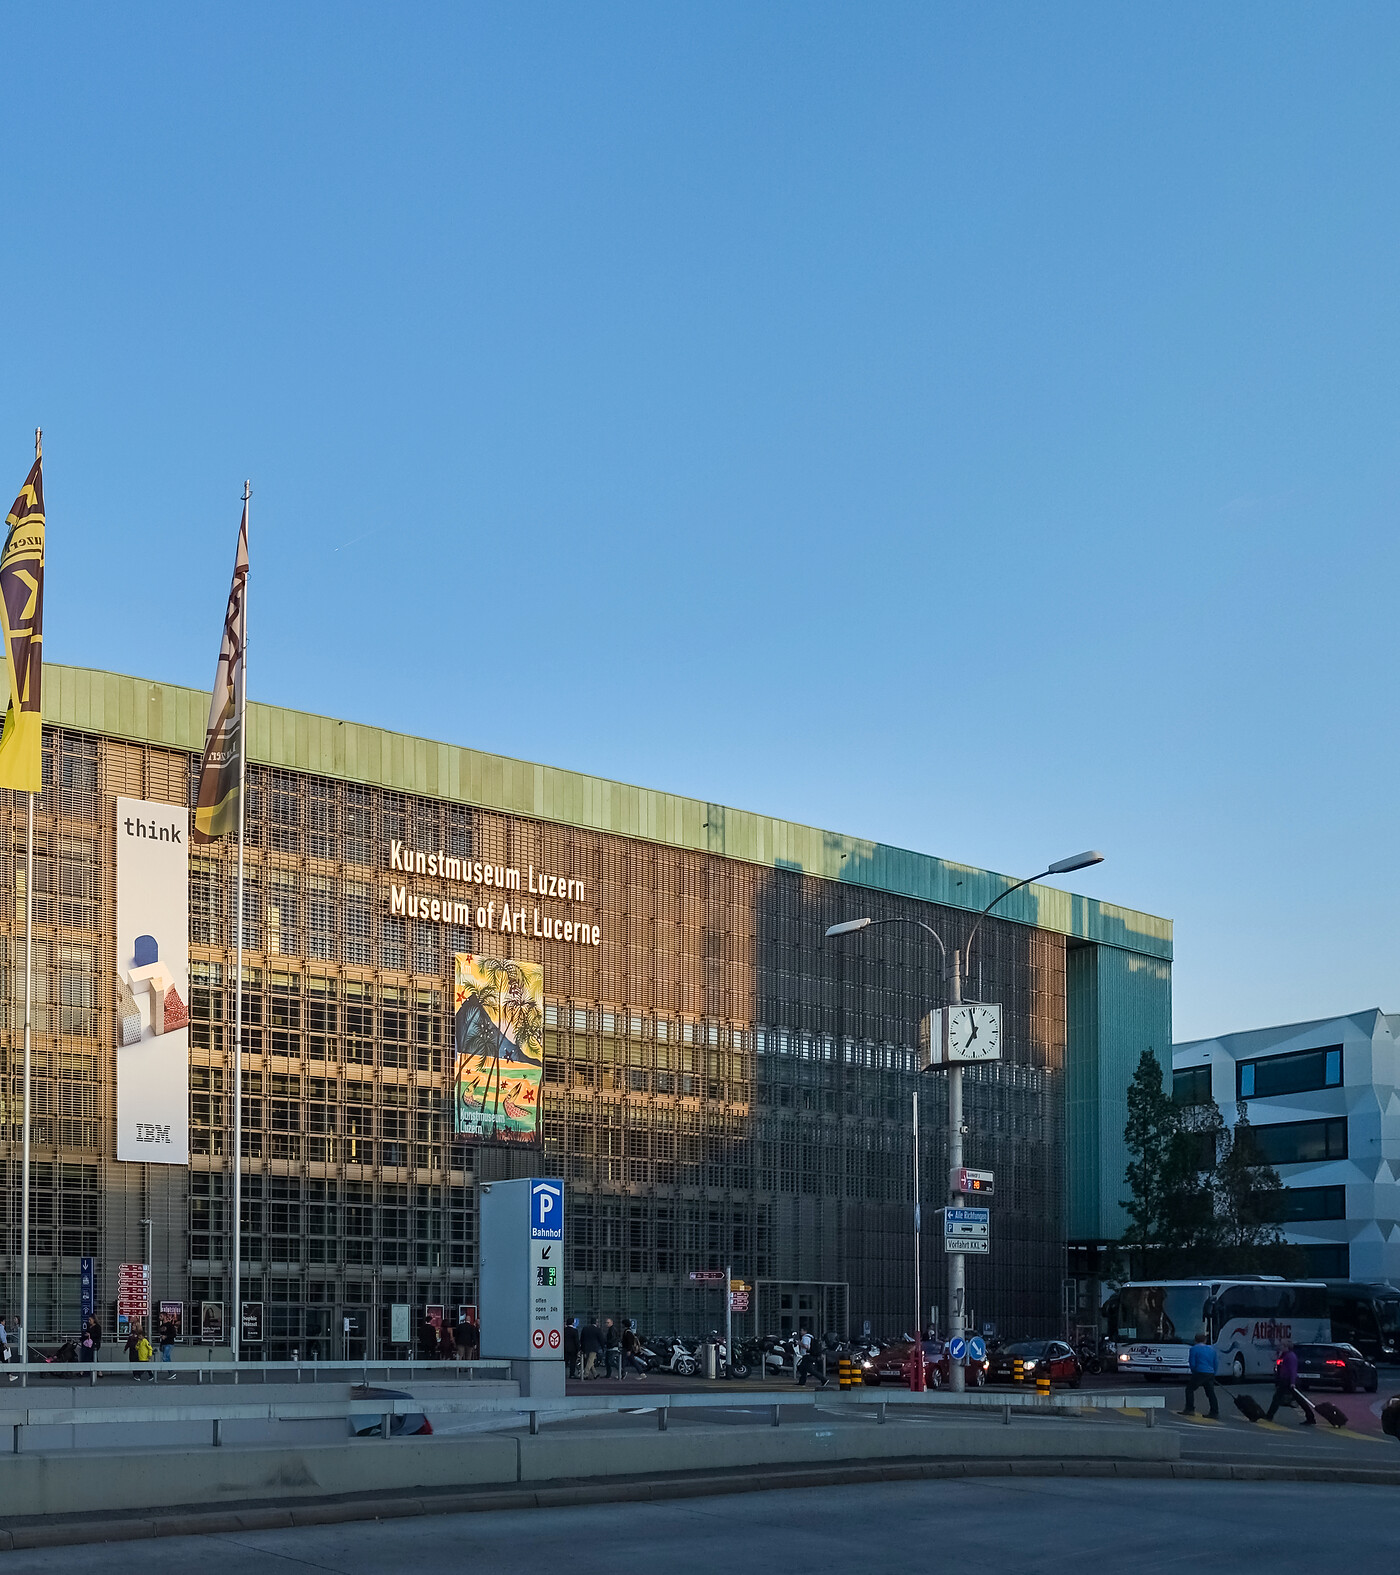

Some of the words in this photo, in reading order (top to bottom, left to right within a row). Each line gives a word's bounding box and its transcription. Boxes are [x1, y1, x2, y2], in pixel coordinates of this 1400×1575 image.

[124, 817, 182, 844] think
[390, 839, 521, 891] Kunstmuseum
[528, 864, 585, 902] Luzern
[391, 884, 469, 926] Museum
[476, 901, 494, 929] of
[500, 903, 527, 935] Art
[534, 908, 601, 946] Lucerne
[460, 1107, 506, 1123] Kunstmuseum
[136, 1123, 171, 1144] IBM
[460, 1120, 483, 1135] Luzern
[539, 1193, 554, 1223] P
[532, 1227, 562, 1238] Bahnhof
[948, 1239, 969, 1249] Vorfahrt
